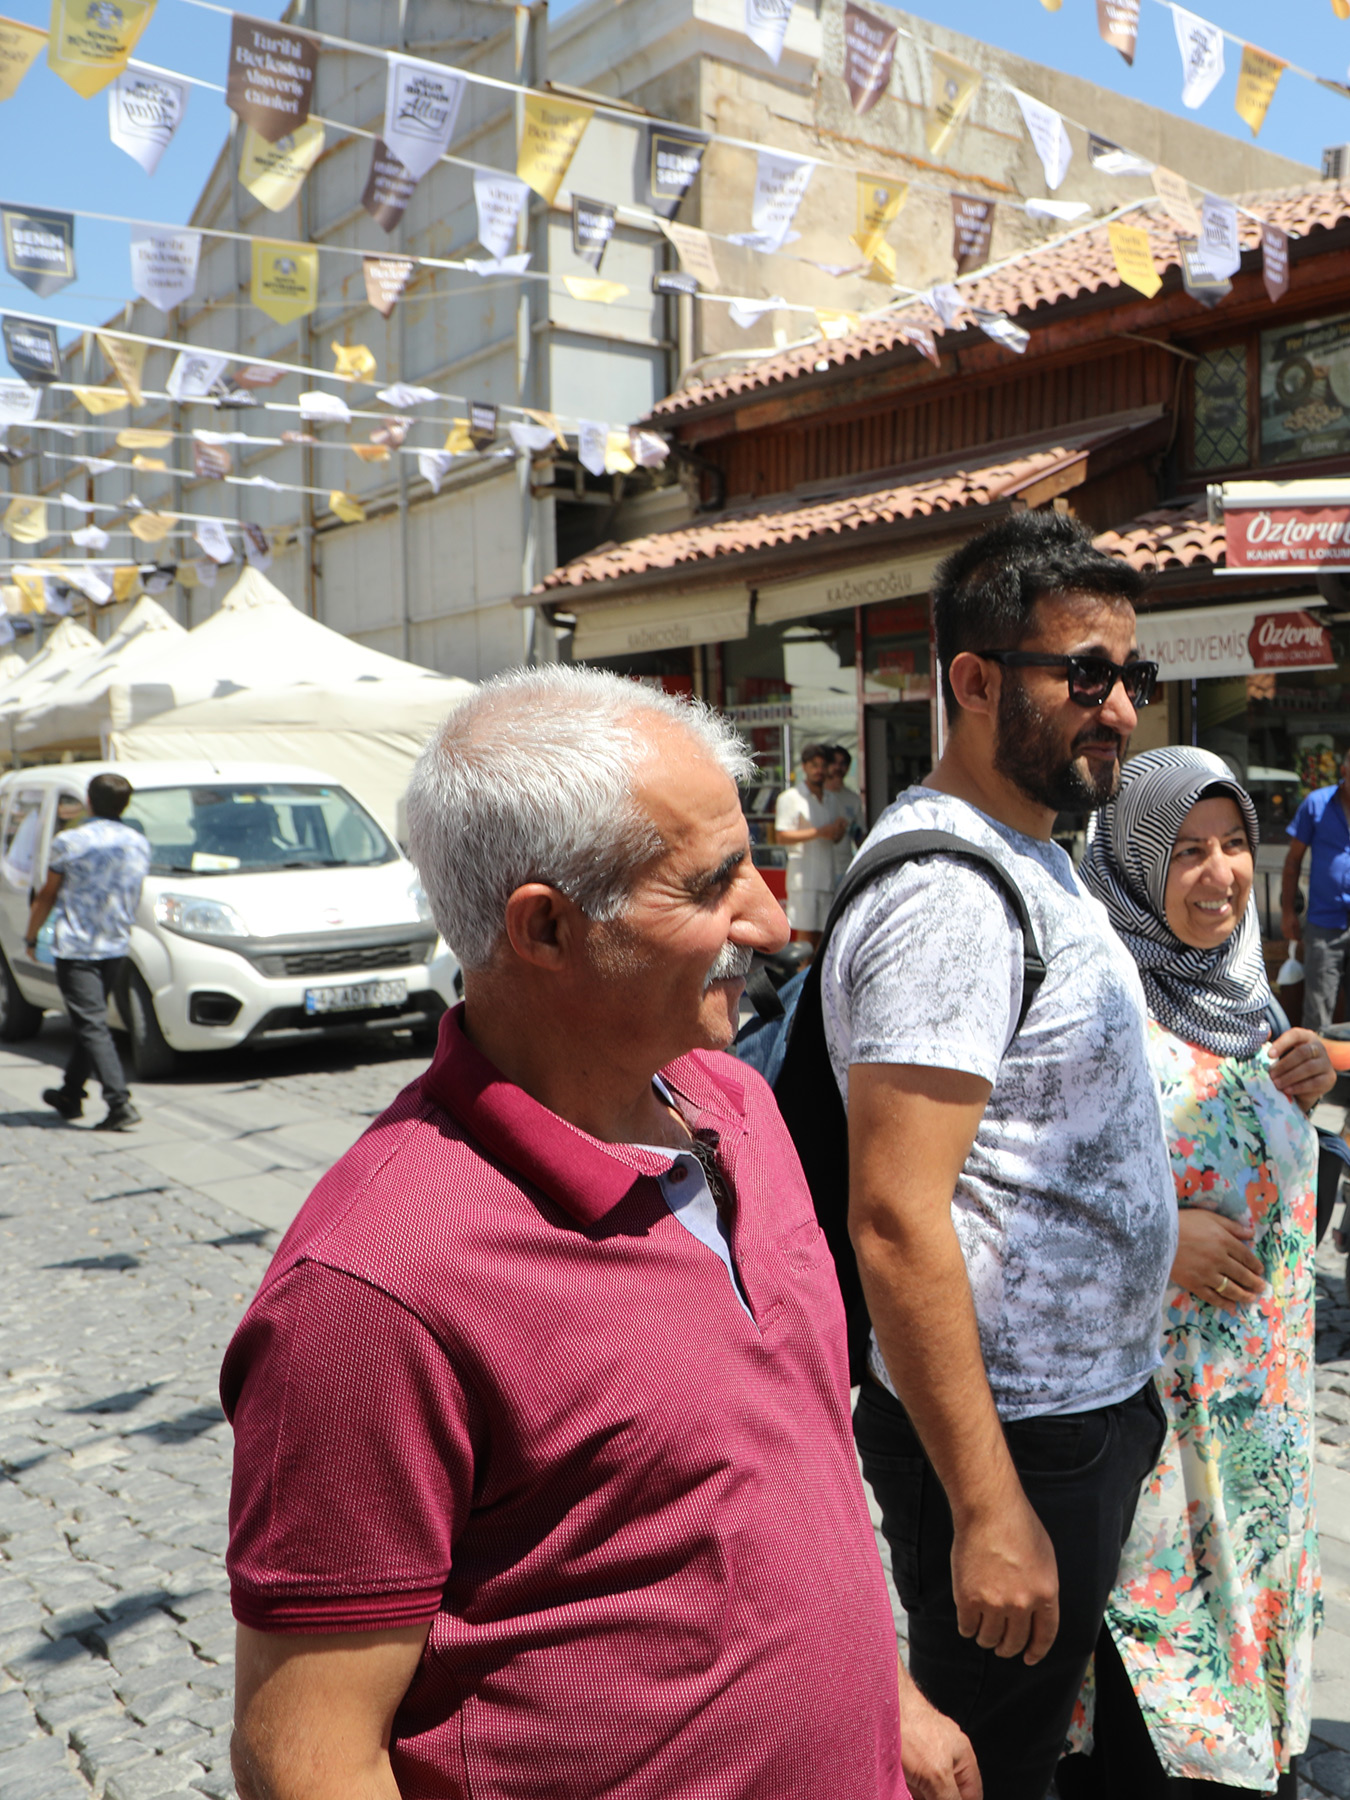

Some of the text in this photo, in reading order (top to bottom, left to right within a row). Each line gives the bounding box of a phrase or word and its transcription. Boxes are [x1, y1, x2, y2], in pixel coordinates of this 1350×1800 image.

[1247, 550, 1288, 561] KAHVE
[1290, 549, 1306, 559] VE
[1155, 630, 1247, 665] KURUYEMİŞ
[1258, 617, 1325, 648] Öztorun
